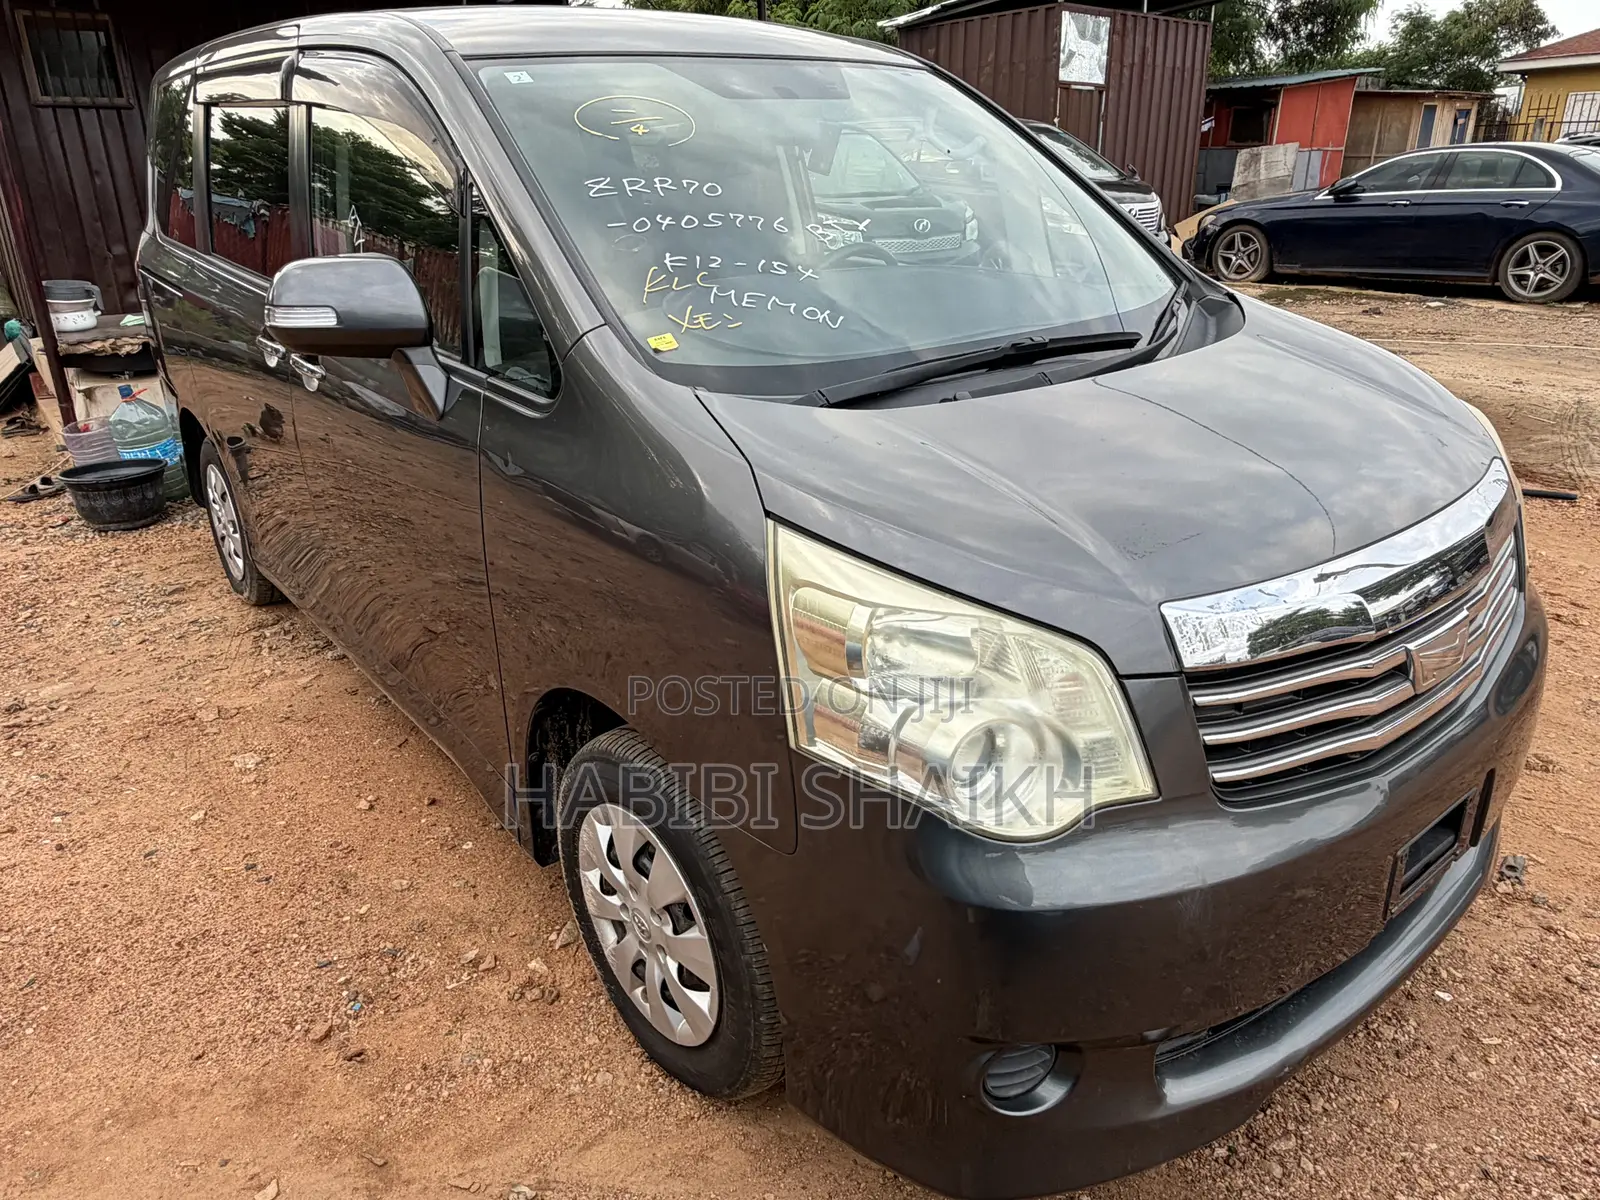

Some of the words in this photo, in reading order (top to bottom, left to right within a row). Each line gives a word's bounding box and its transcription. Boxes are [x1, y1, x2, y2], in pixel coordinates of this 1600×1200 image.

[629, 123, 650, 136] 4
[583, 176, 723, 198] ZRR70
[606, 212, 790, 233] -0405776
[710, 286, 845, 330] MEMON
